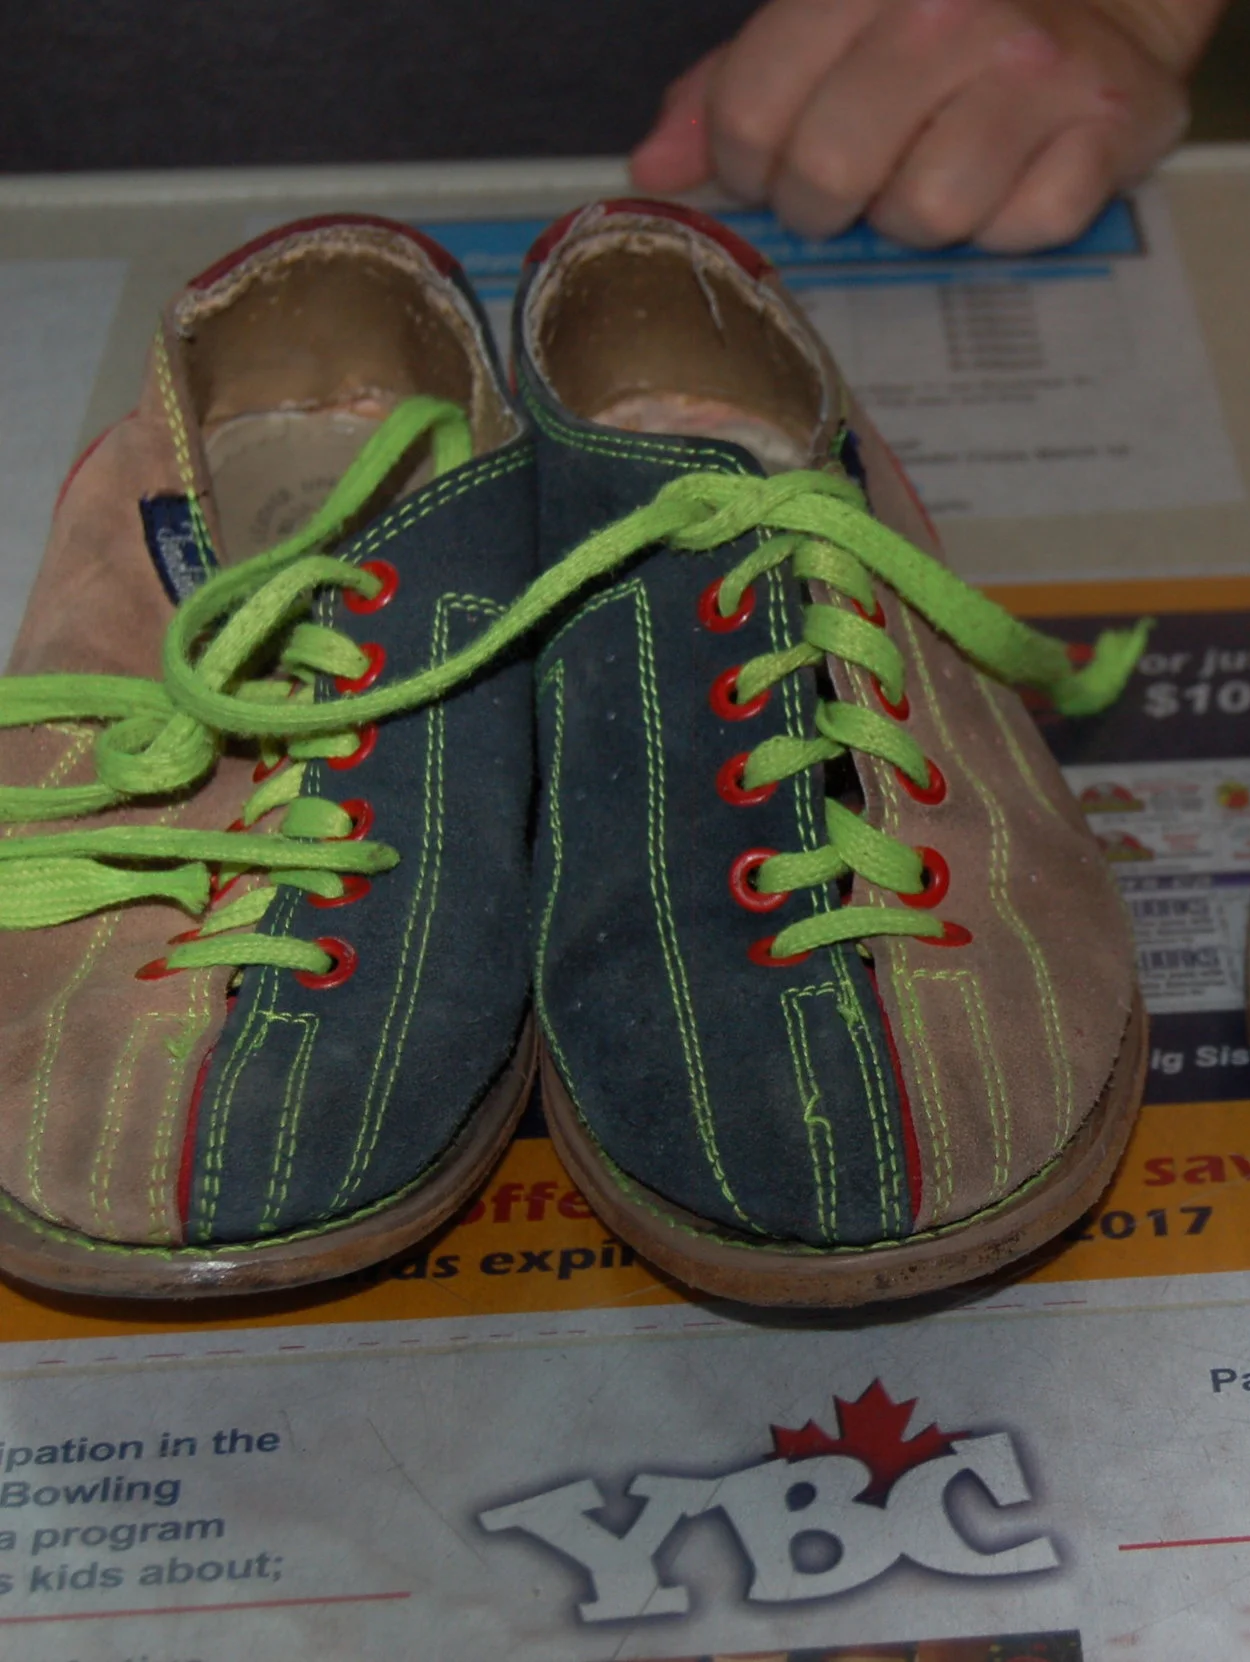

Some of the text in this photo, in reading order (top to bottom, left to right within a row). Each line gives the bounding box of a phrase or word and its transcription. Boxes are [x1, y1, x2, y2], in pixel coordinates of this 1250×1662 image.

[1150, 1048, 1184, 1076] ig
[158, 1432, 197, 1458] in
[211, 1428, 281, 1455] the
[0, 1475, 182, 1508] Bowling
[31, 1517, 226, 1555] program
[478, 1431, 1060, 1622] YBC
[29, 1561, 124, 1593] kids
[138, 1551, 284, 1586] about;
